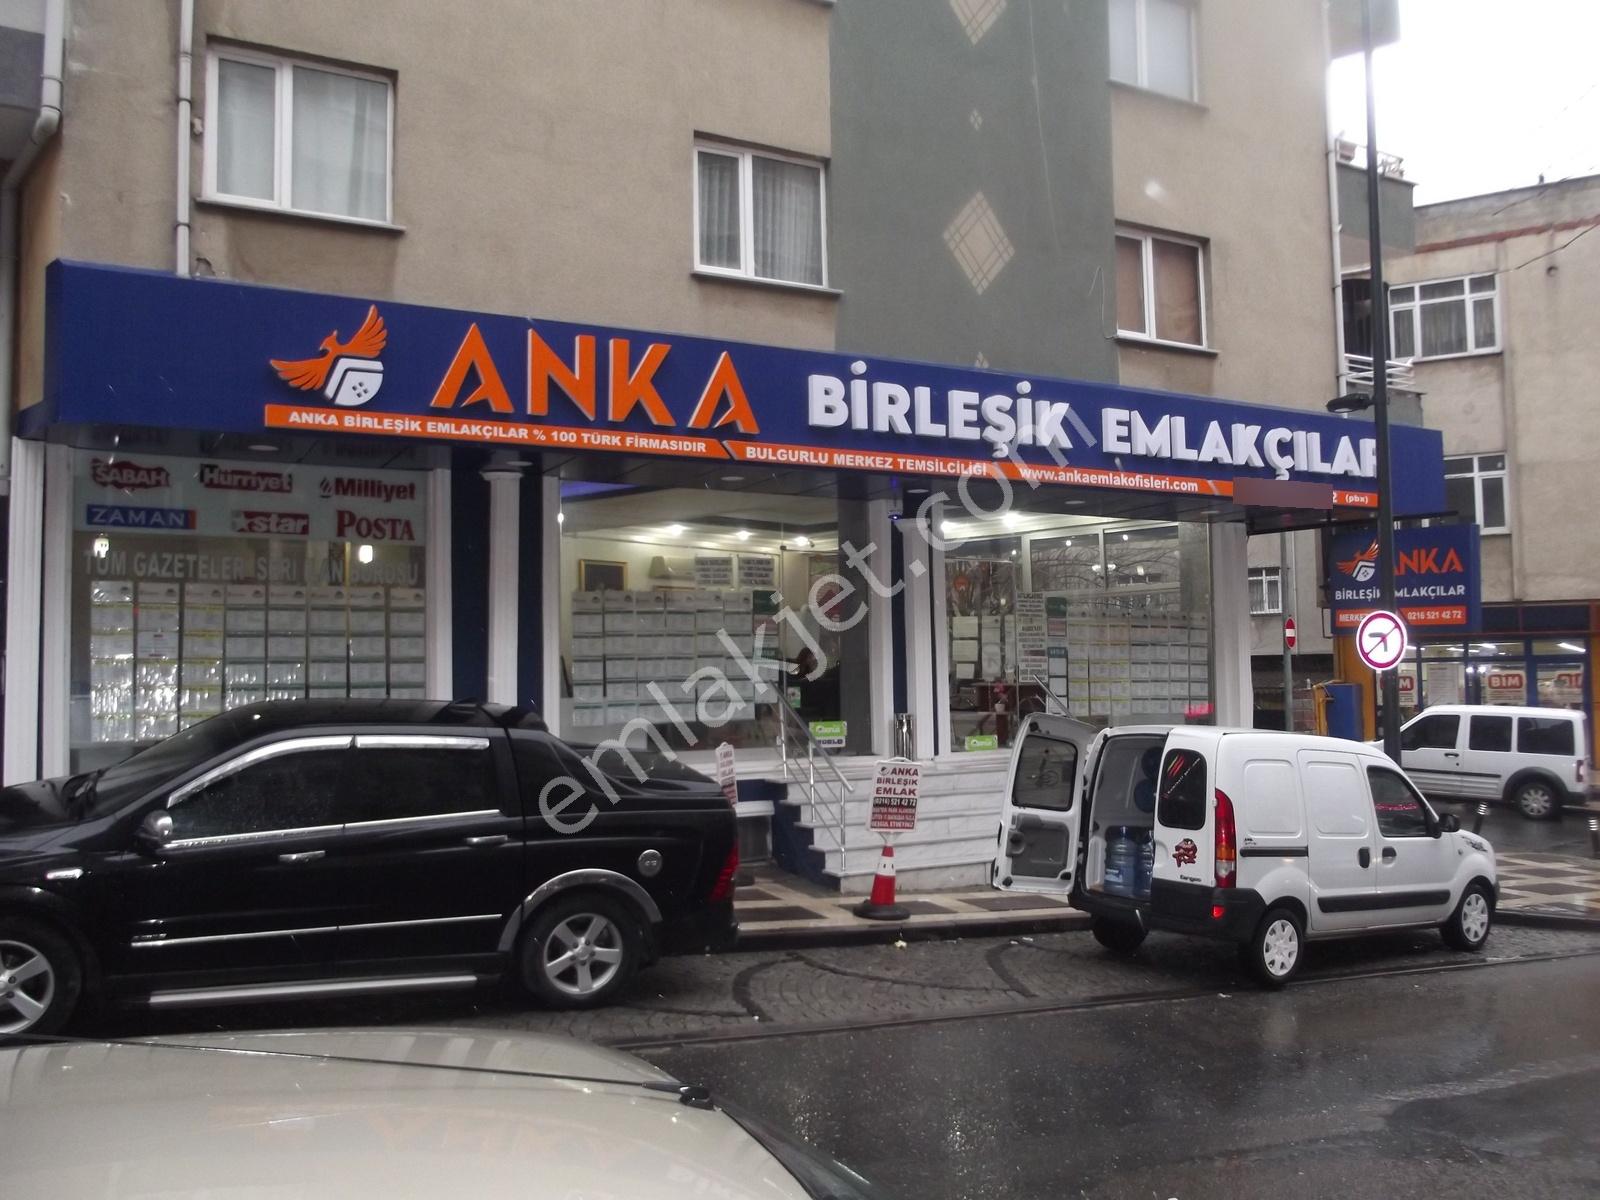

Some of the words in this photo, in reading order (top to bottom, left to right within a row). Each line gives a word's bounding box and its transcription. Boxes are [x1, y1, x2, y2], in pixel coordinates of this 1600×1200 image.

[430, 321, 760, 434] ANKA
[808, 360, 1074, 458] BİRLEŞİK
[289, 411, 339, 428] ANKA
[343, 412, 423, 434] BİRLEŞİK
[427, 421, 529, 441] EMLAKÇILAR
[532, 428, 547, 442] %
[551, 430, 577, 445] 100
[581, 430, 622, 449] TÜRK
[626, 434, 707, 454] FİRMASIDIR
[746, 446, 829, 466] BULGURLU
[833, 454, 893, 470] MERKEZ
[95, 466, 167, 486] SABAH
[1019, 468, 1199, 492] www.ankaemlakofisleri.com
[334, 477, 416, 503] Milliyet
[1345, 494, 1369, 505] (pbx)
[92, 508, 185, 527] ZAMAN
[252, 513, 308, 534] star
[336, 509, 415, 541] POSTA
[133, 552, 245, 581] GAZETELER
[1394, 547, 1464, 576] NKA
[1394, 584, 1465, 600] MLAKÇILAR
[891, 767, 919, 776] ANKA
[876, 786, 916, 796] EMLAK
